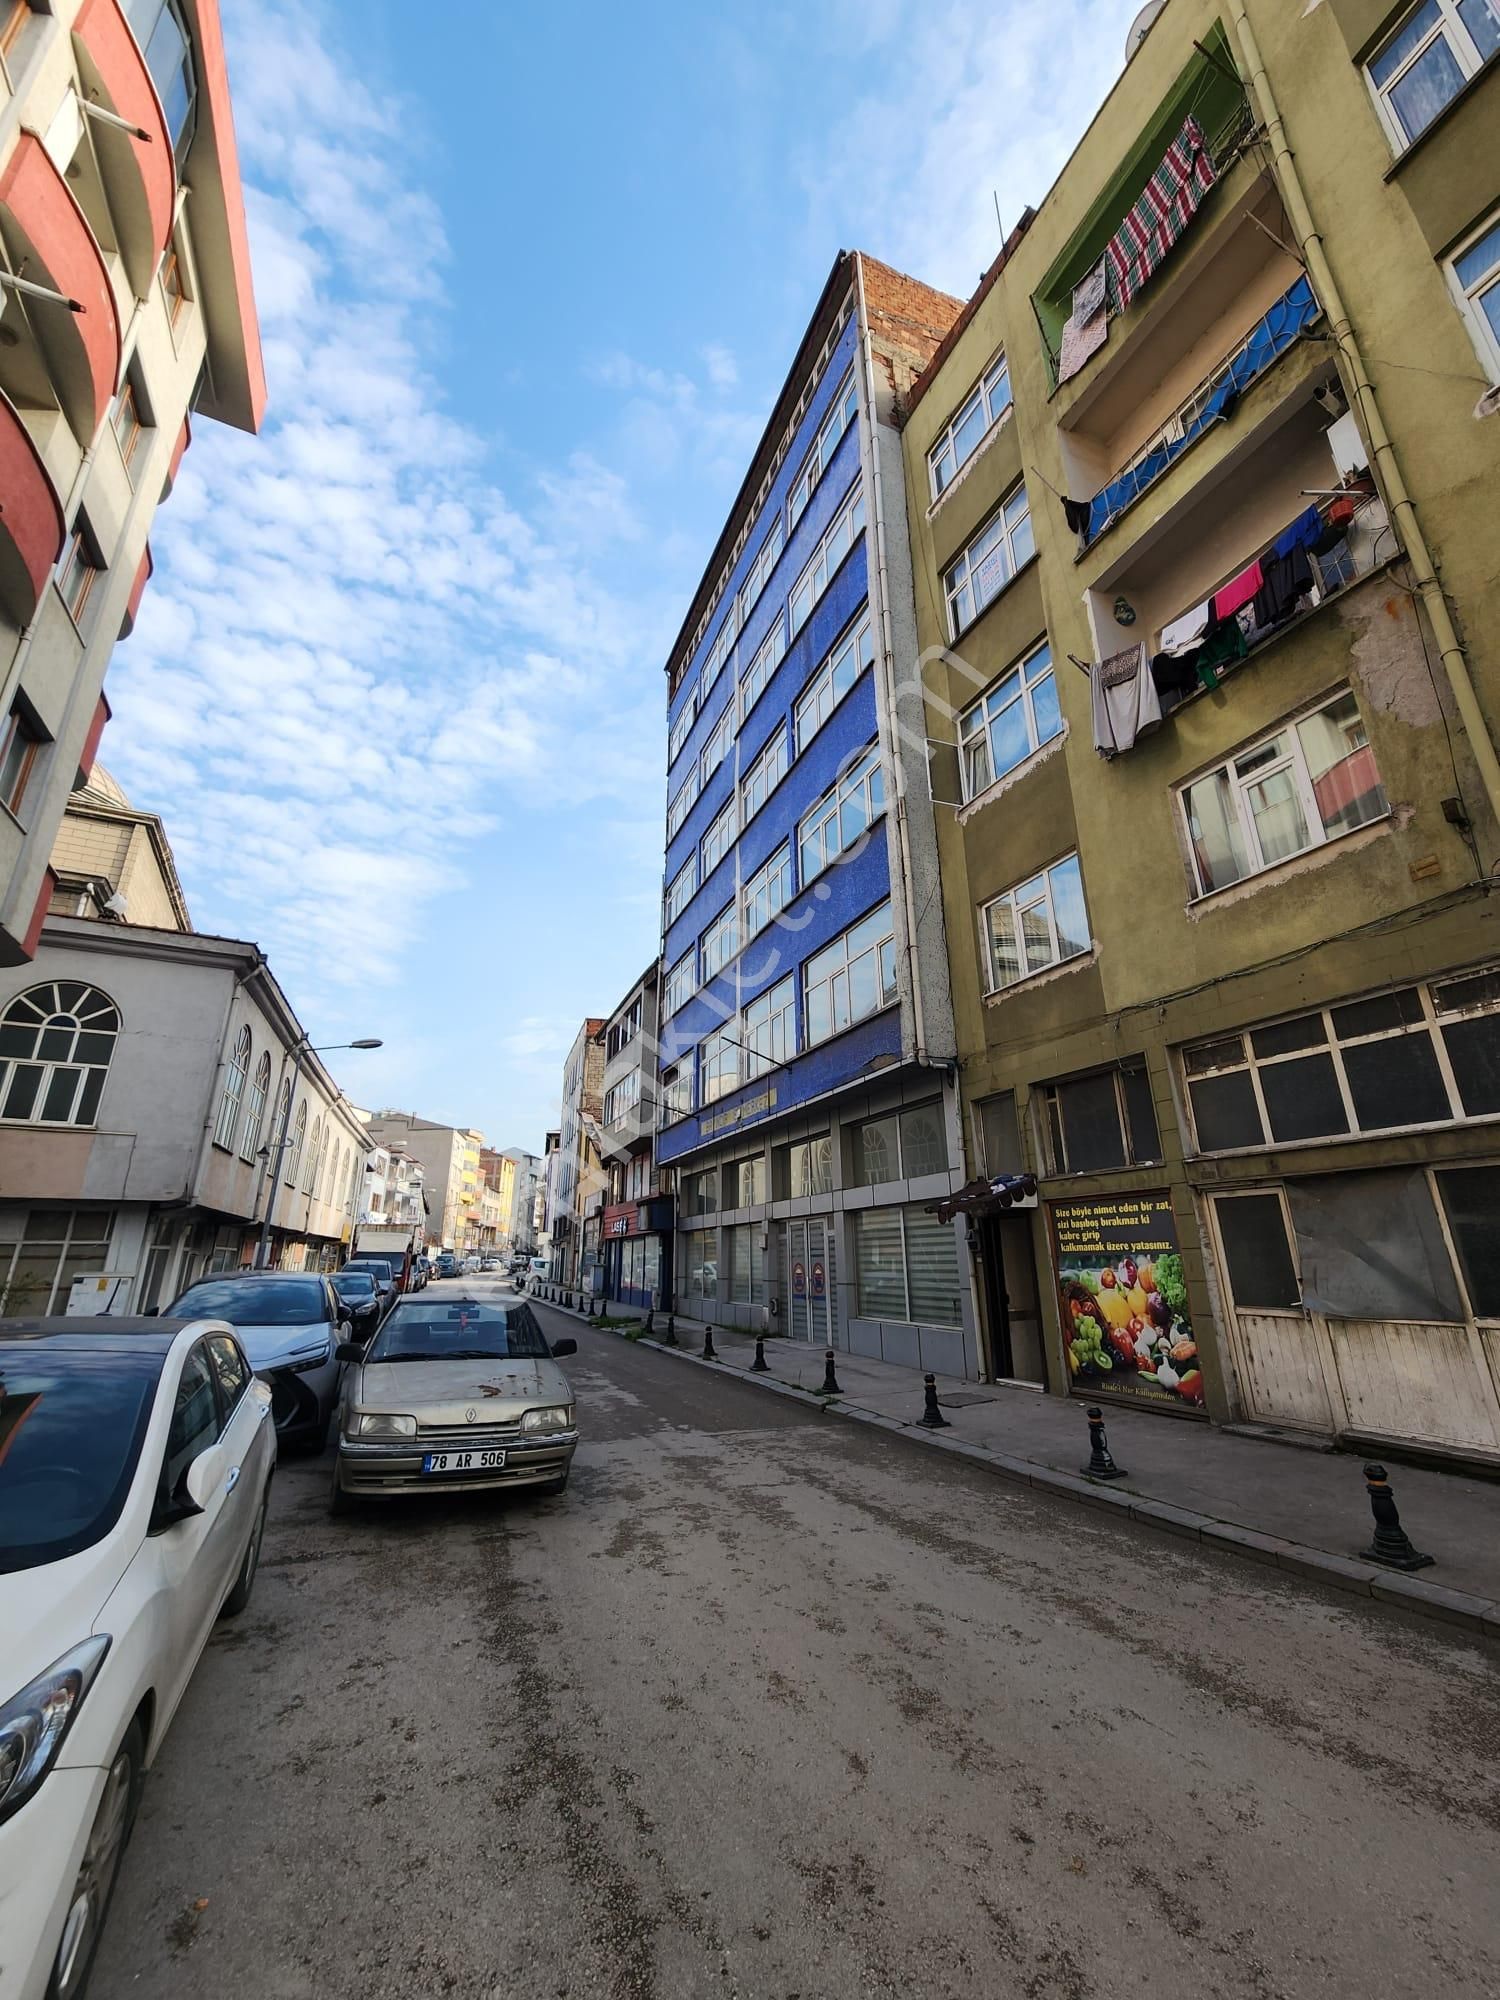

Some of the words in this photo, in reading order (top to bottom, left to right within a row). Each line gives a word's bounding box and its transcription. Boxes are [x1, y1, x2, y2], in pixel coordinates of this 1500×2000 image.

[1055, 1209, 1070, 1218] Size
[1071, 1207, 1092, 1218] böyle
[1093, 1205, 1117, 1215] nimet
[1119, 1203, 1138, 1213] eden
[1140, 1201, 1153, 1211] bir
[1057, 1221, 1070, 1229] sizi
[1071, 1218, 1099, 1230] başıboş
[1100, 1216, 1140, 1227] bırakmaz
[1141, 1214, 1150, 1224] ki
[1059, 1231, 1080, 1241] kabre
[1082, 1230, 1101, 1242] girip
[1061, 1242, 1105, 1252] kalkmamak
[1106, 1242, 1129, 1251] üzere
[1131, 1241, 1173, 1253] yatasınız.
[431, 1455, 448, 1470] 78
[456, 1453, 472, 1468] AR
[480, 1452, 505, 1467] 506
